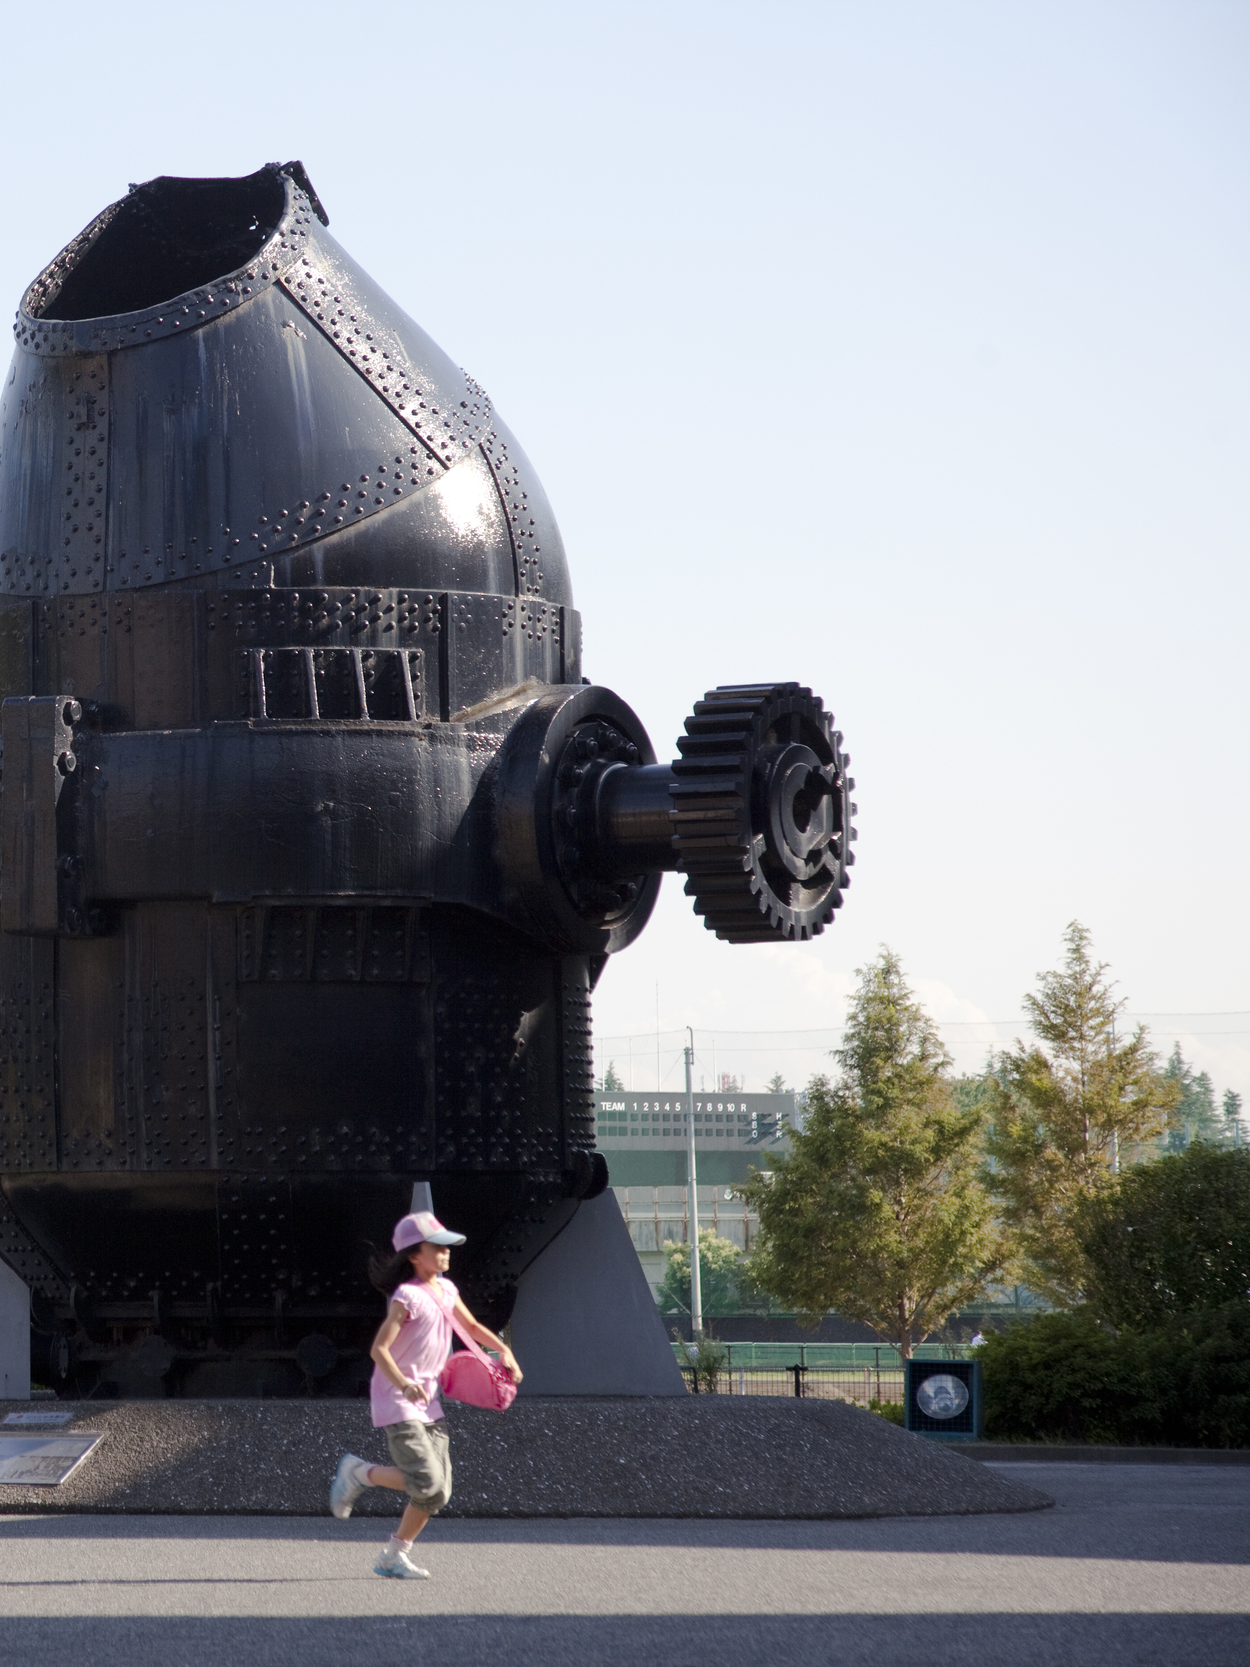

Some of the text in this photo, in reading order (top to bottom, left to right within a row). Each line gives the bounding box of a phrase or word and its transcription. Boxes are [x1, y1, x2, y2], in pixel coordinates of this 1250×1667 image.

[600, 1101, 626, 1111] TEAM
[632, 1102, 638, 1111] 1
[643, 1102, 649, 1111] 2
[653, 1102, 660, 1111] 3
[664, 1102, 670, 1111] 4
[675, 1102, 681, 1111] 5
[696, 1102, 702, 1112] 7
[706, 1102, 713, 1112] 8
[717, 1103, 723, 1112] 9
[726, 1103, 735, 1112] 10
[740, 1103, 747, 1112] R
[776, 1112, 782, 1120] H
